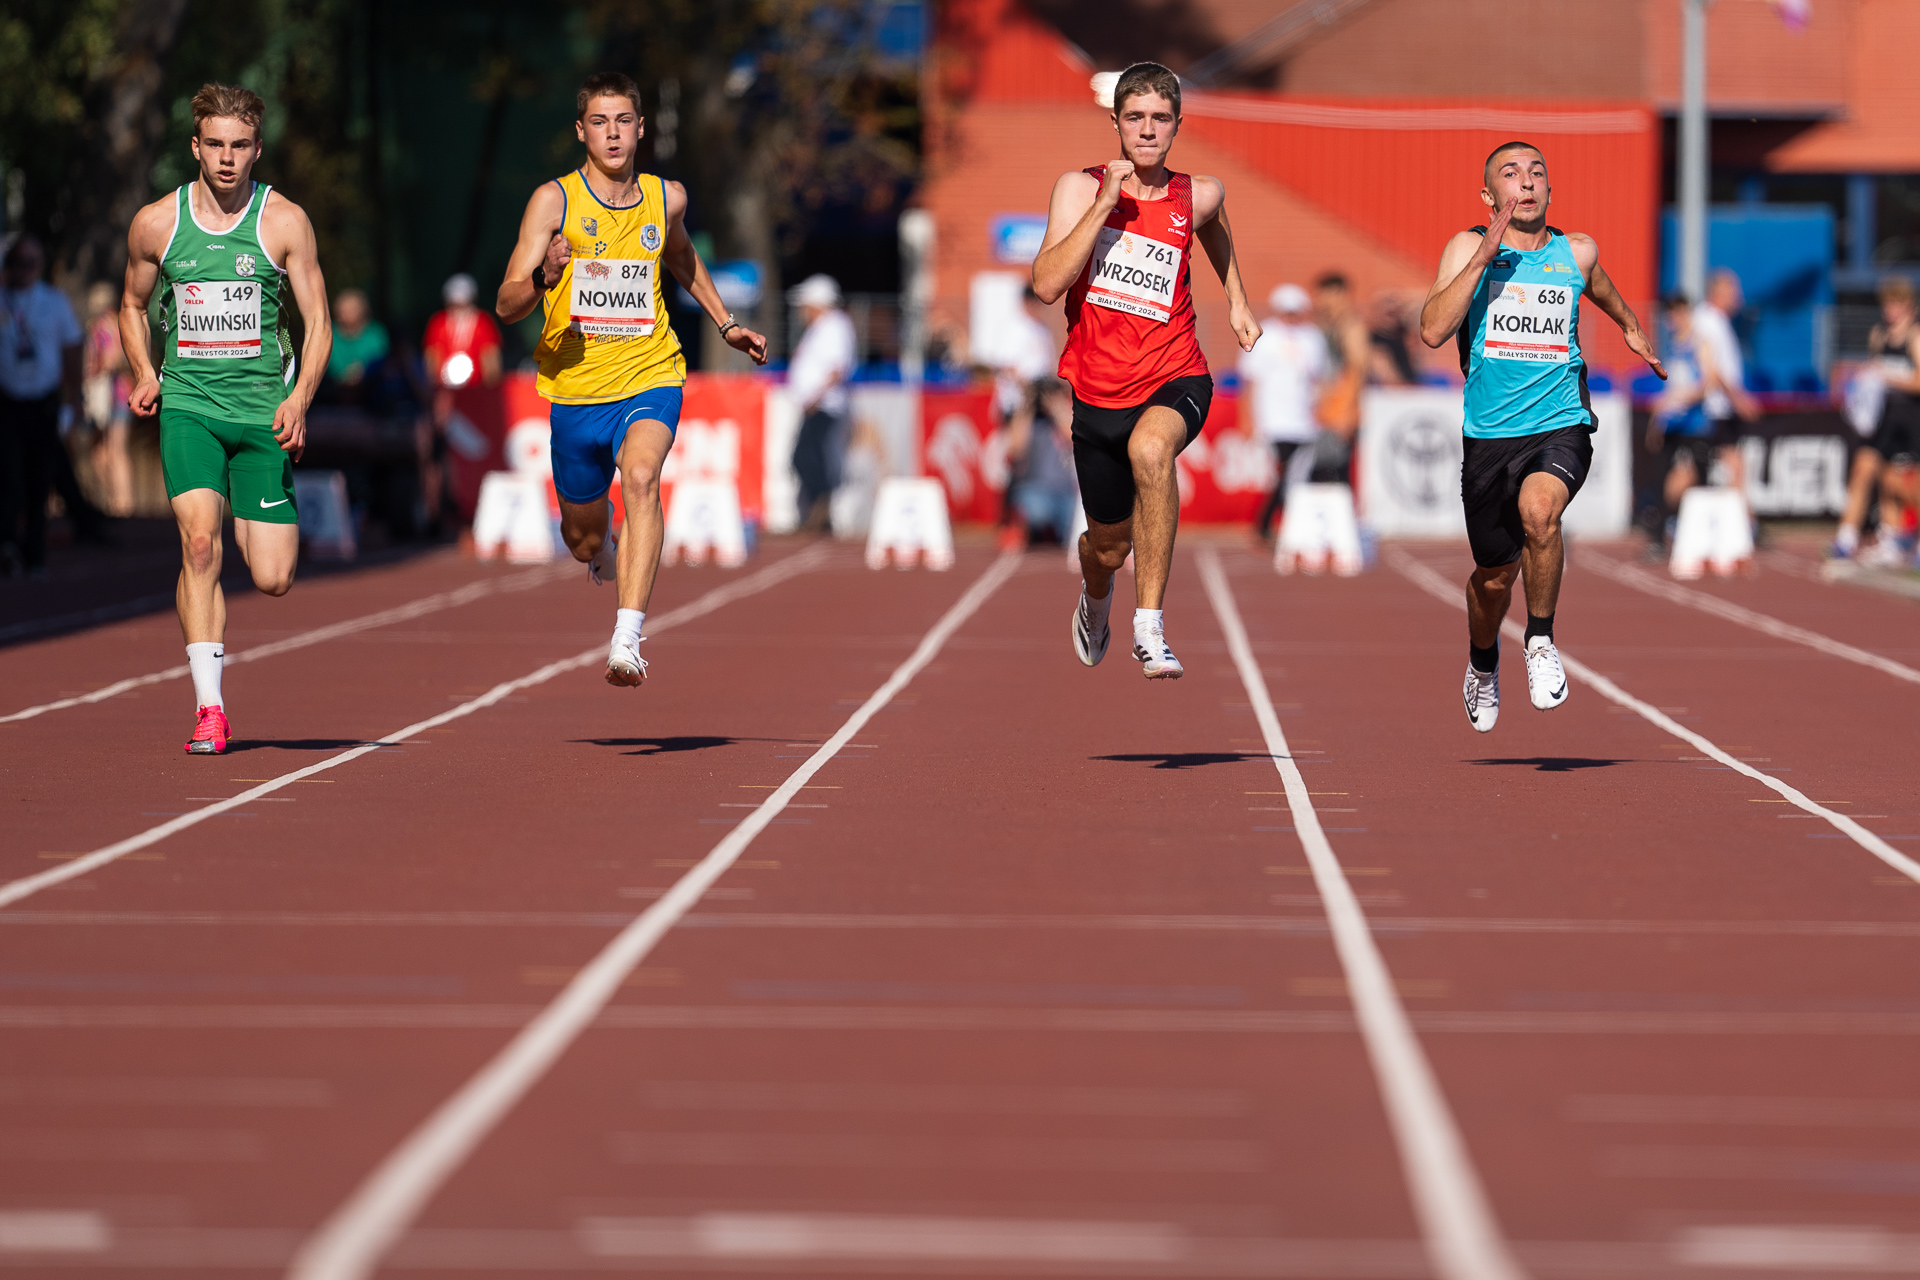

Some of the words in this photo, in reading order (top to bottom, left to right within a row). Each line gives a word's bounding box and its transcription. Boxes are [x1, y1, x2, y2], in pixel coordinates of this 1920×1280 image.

[1145, 243, 1174, 266] 761
[621, 264, 648, 280] 874
[1096, 258, 1171, 296] WRZOSEK
[222, 286, 254, 302] 149
[578, 289, 648, 309] NOWAK
[1537, 289, 1566, 305] 636
[1097, 296, 1137, 312] BIAŁYSTOK
[1138, 307, 1156, 317] 2024
[180, 311, 257, 332] ŚLIWIŃSKI
[583, 325, 624, 333] BIAŁYSTOK
[1492, 313, 1566, 336] KORLAK
[1498, 350, 1539, 360] BIAŁYSTOK
